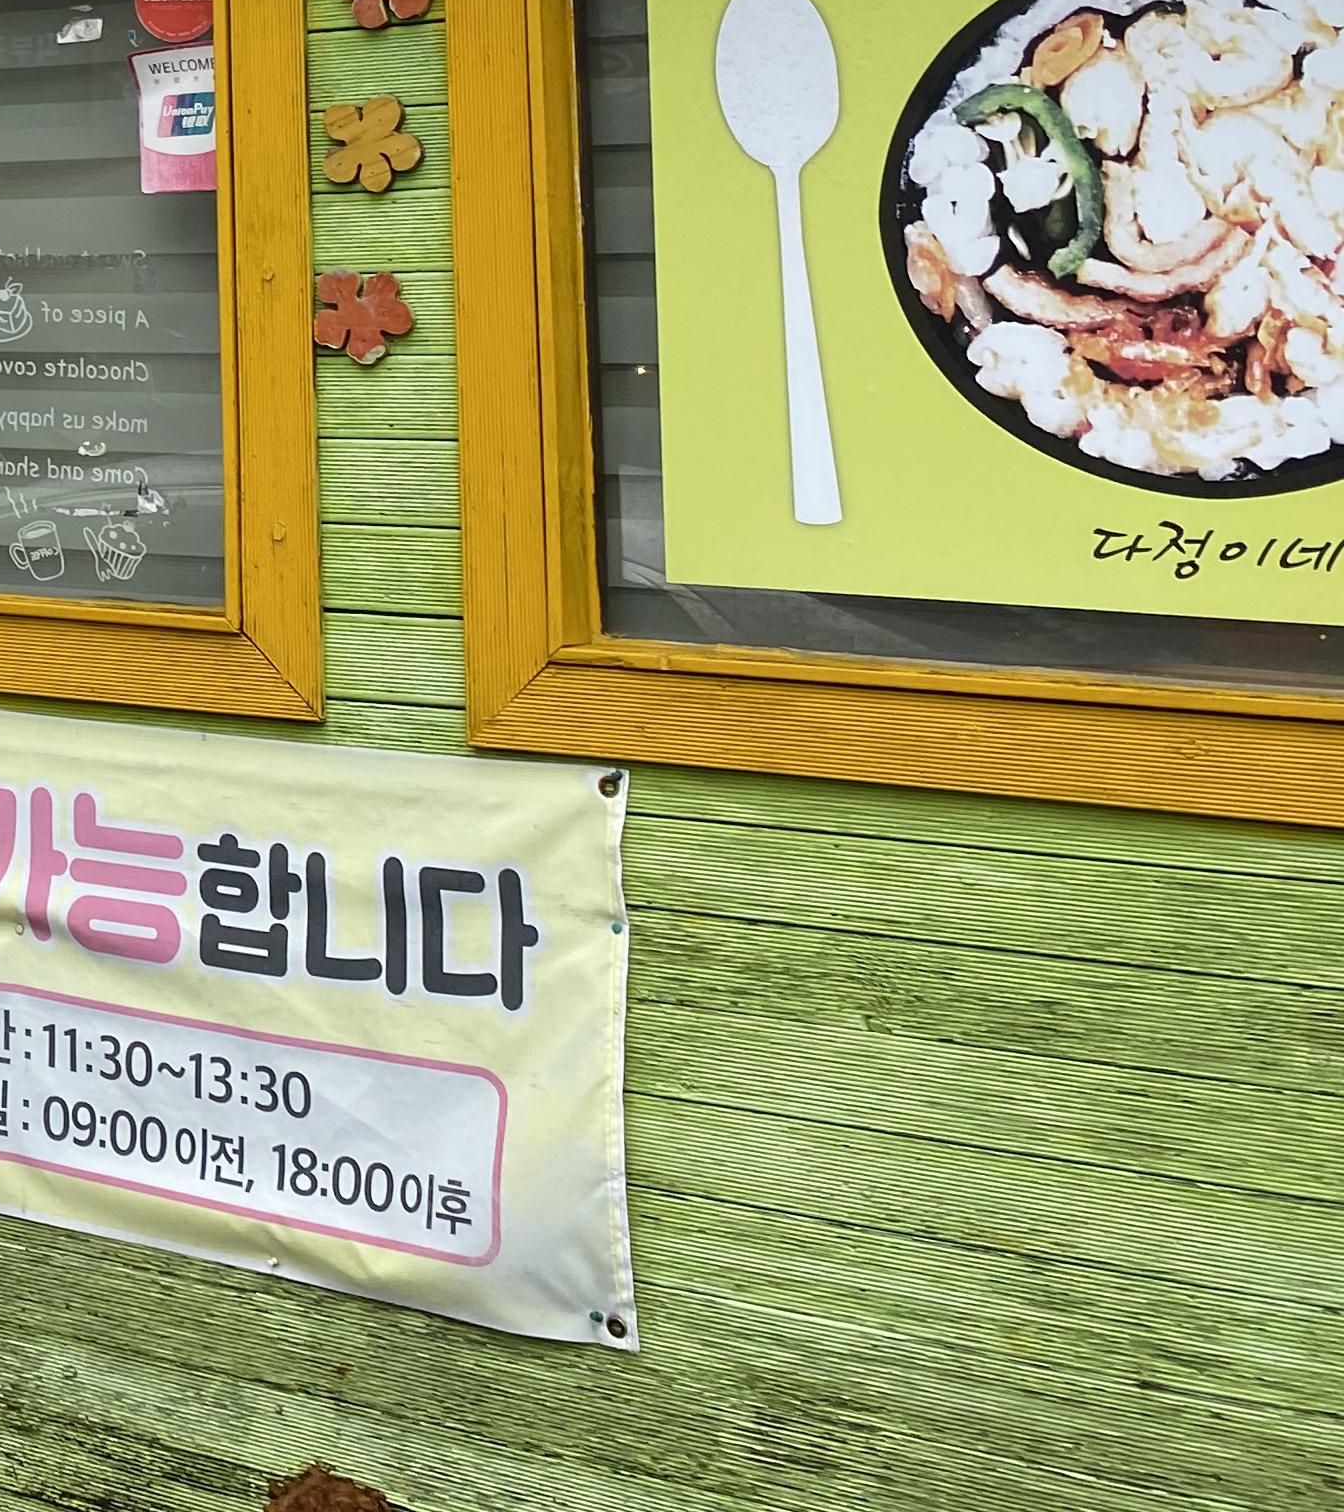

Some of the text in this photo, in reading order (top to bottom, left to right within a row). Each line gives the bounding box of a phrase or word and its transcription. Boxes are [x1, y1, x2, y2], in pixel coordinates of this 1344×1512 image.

[148, 57, 215, 75] WELCOME
[1092, 520, 1344, 580] 다정이네
[271, 1143, 474, 1236] 18:00이후
